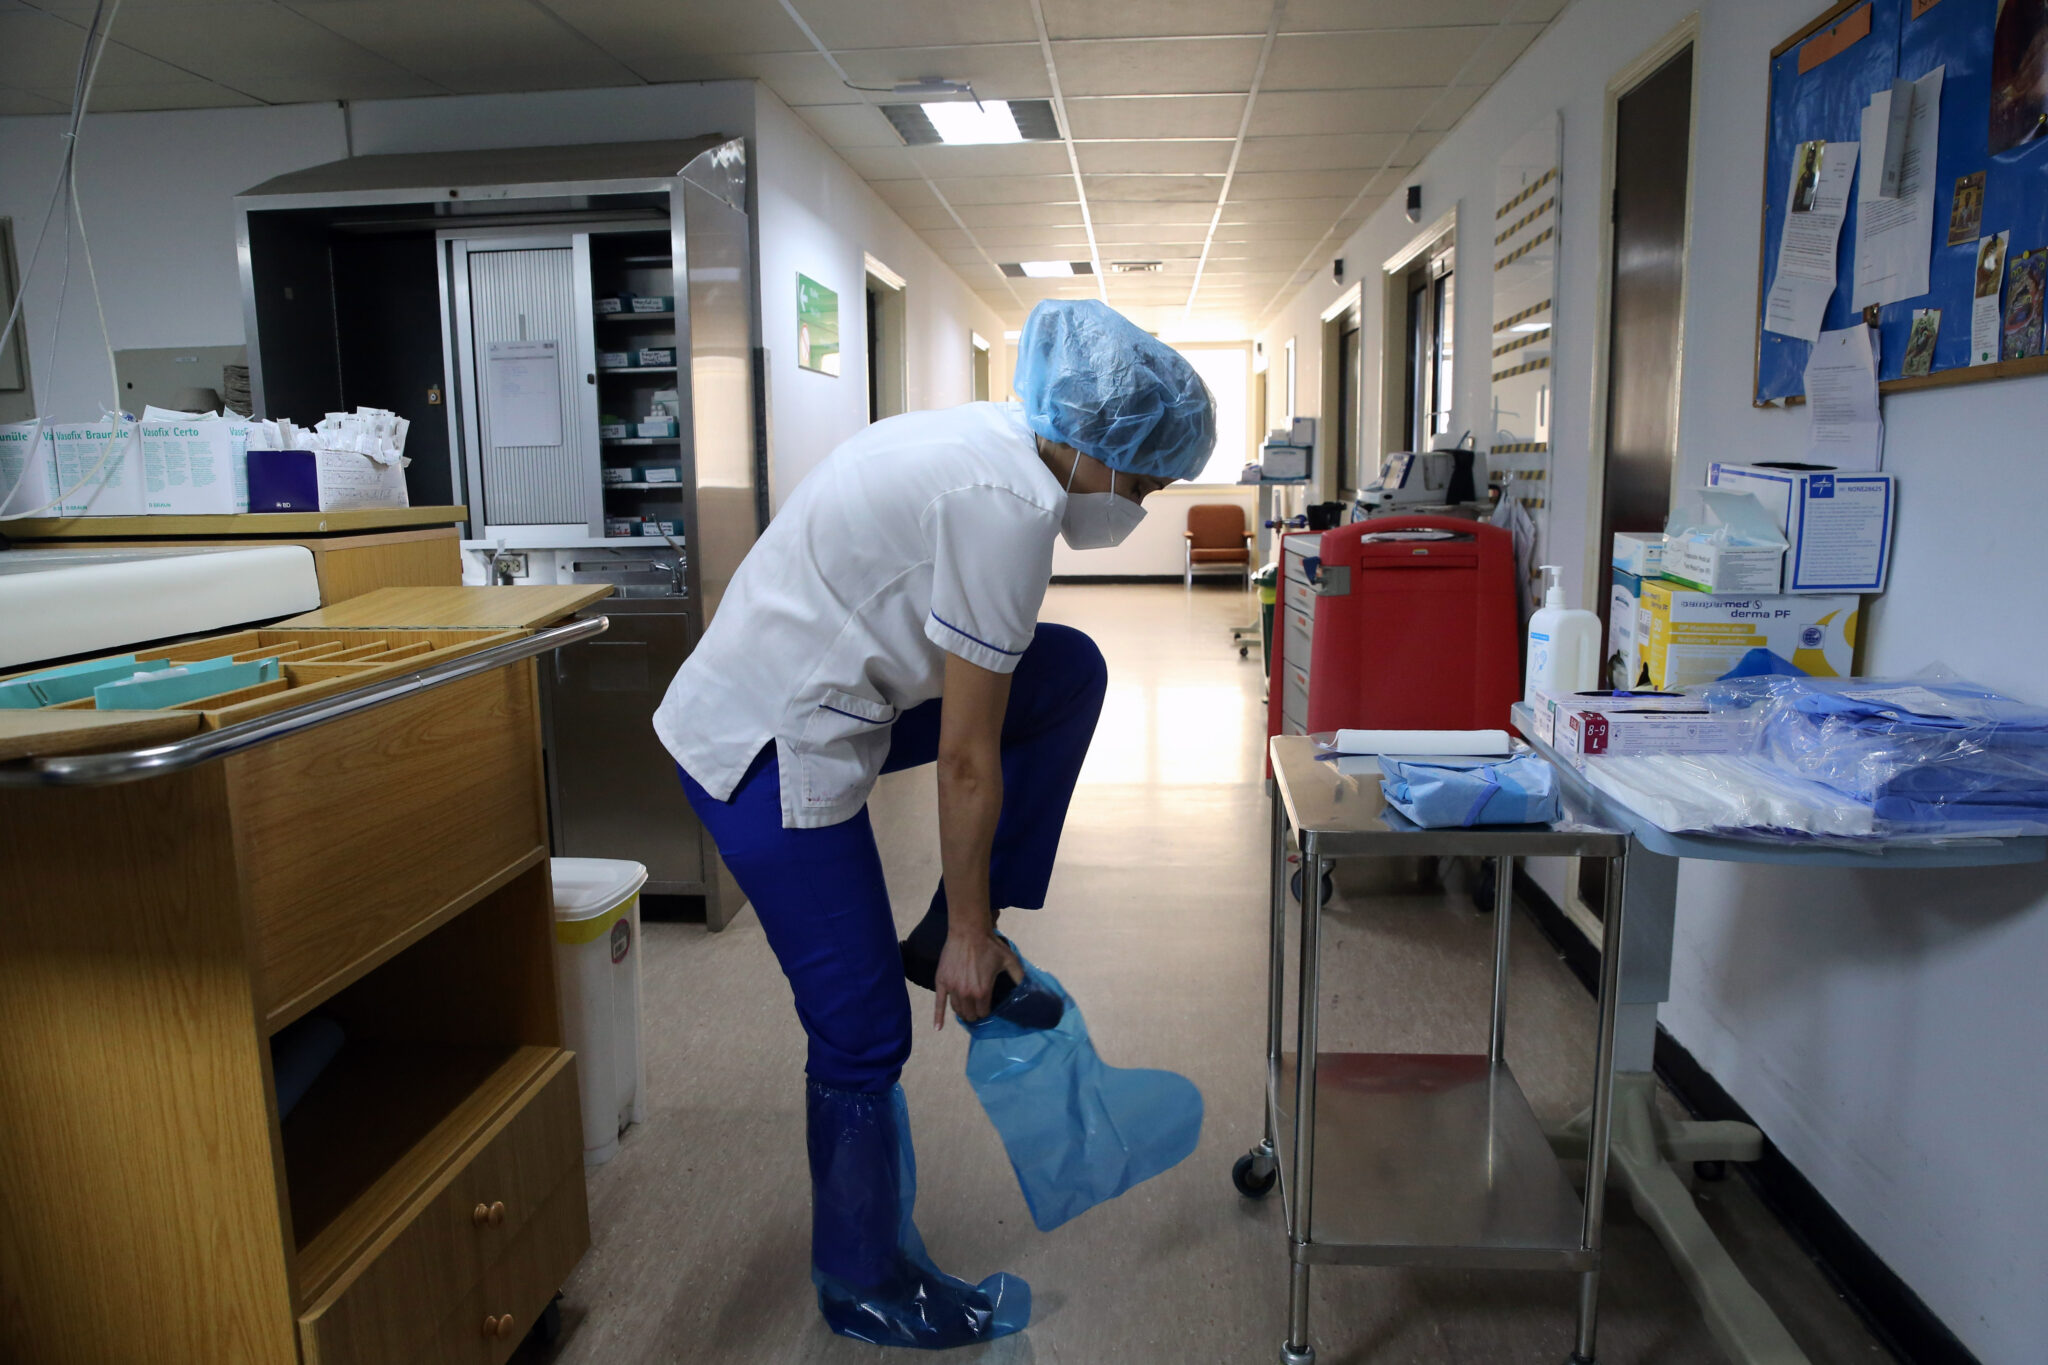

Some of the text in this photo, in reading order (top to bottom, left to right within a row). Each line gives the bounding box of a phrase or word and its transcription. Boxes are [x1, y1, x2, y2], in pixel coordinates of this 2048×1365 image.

[56, 430, 82, 441] Vasofix
[142, 427, 199, 437] Vasofix Certo
[1731, 609, 1791, 619] derma PF
[1587, 724, 1606, 736] 8-9
[1592, 737, 1599, 749] L
